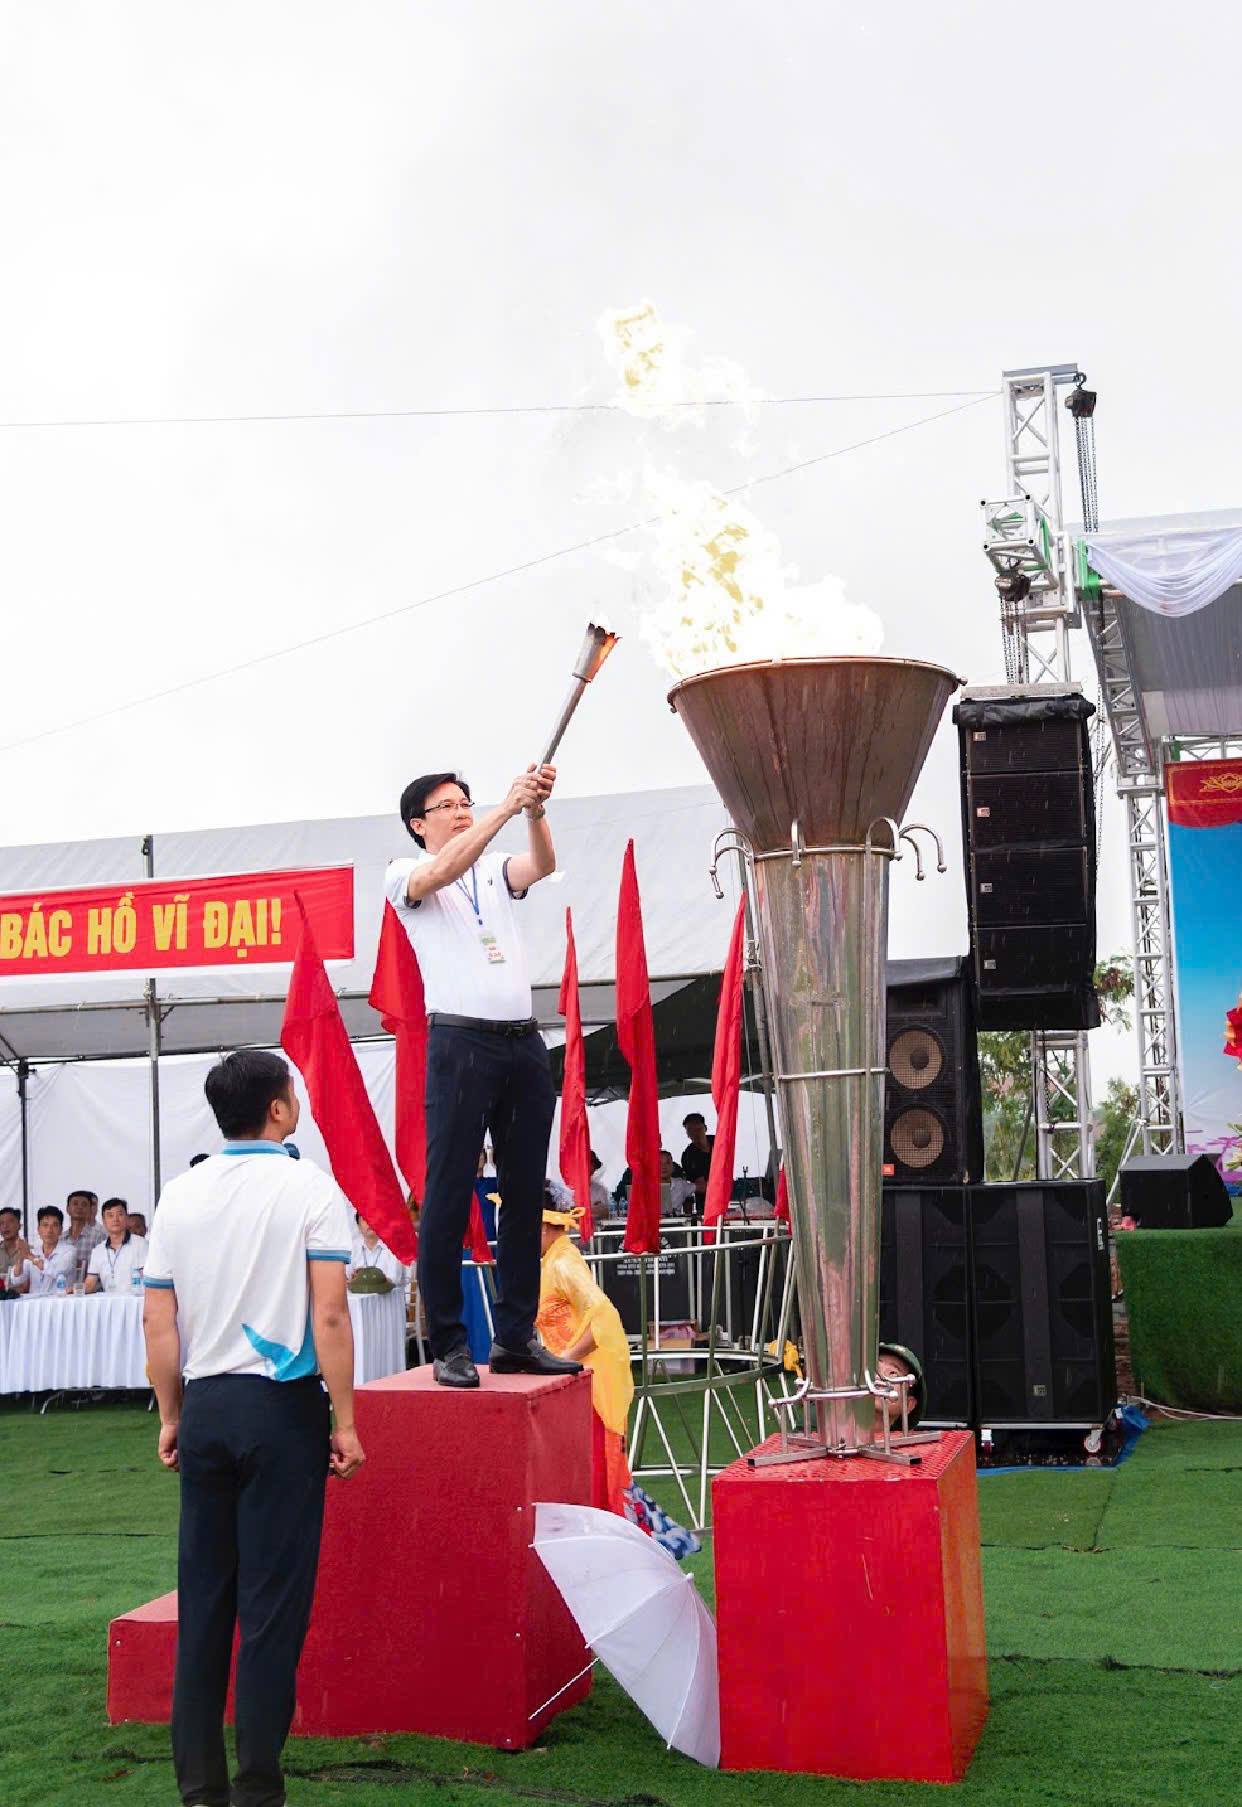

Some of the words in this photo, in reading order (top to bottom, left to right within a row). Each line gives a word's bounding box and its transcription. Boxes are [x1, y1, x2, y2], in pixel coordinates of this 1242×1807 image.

[0, 902, 73, 960] BÁC
[87, 891, 137, 955] HỒ
[152, 893, 191, 951] VĨ
[202, 897, 282, 958] ĐẠI!
